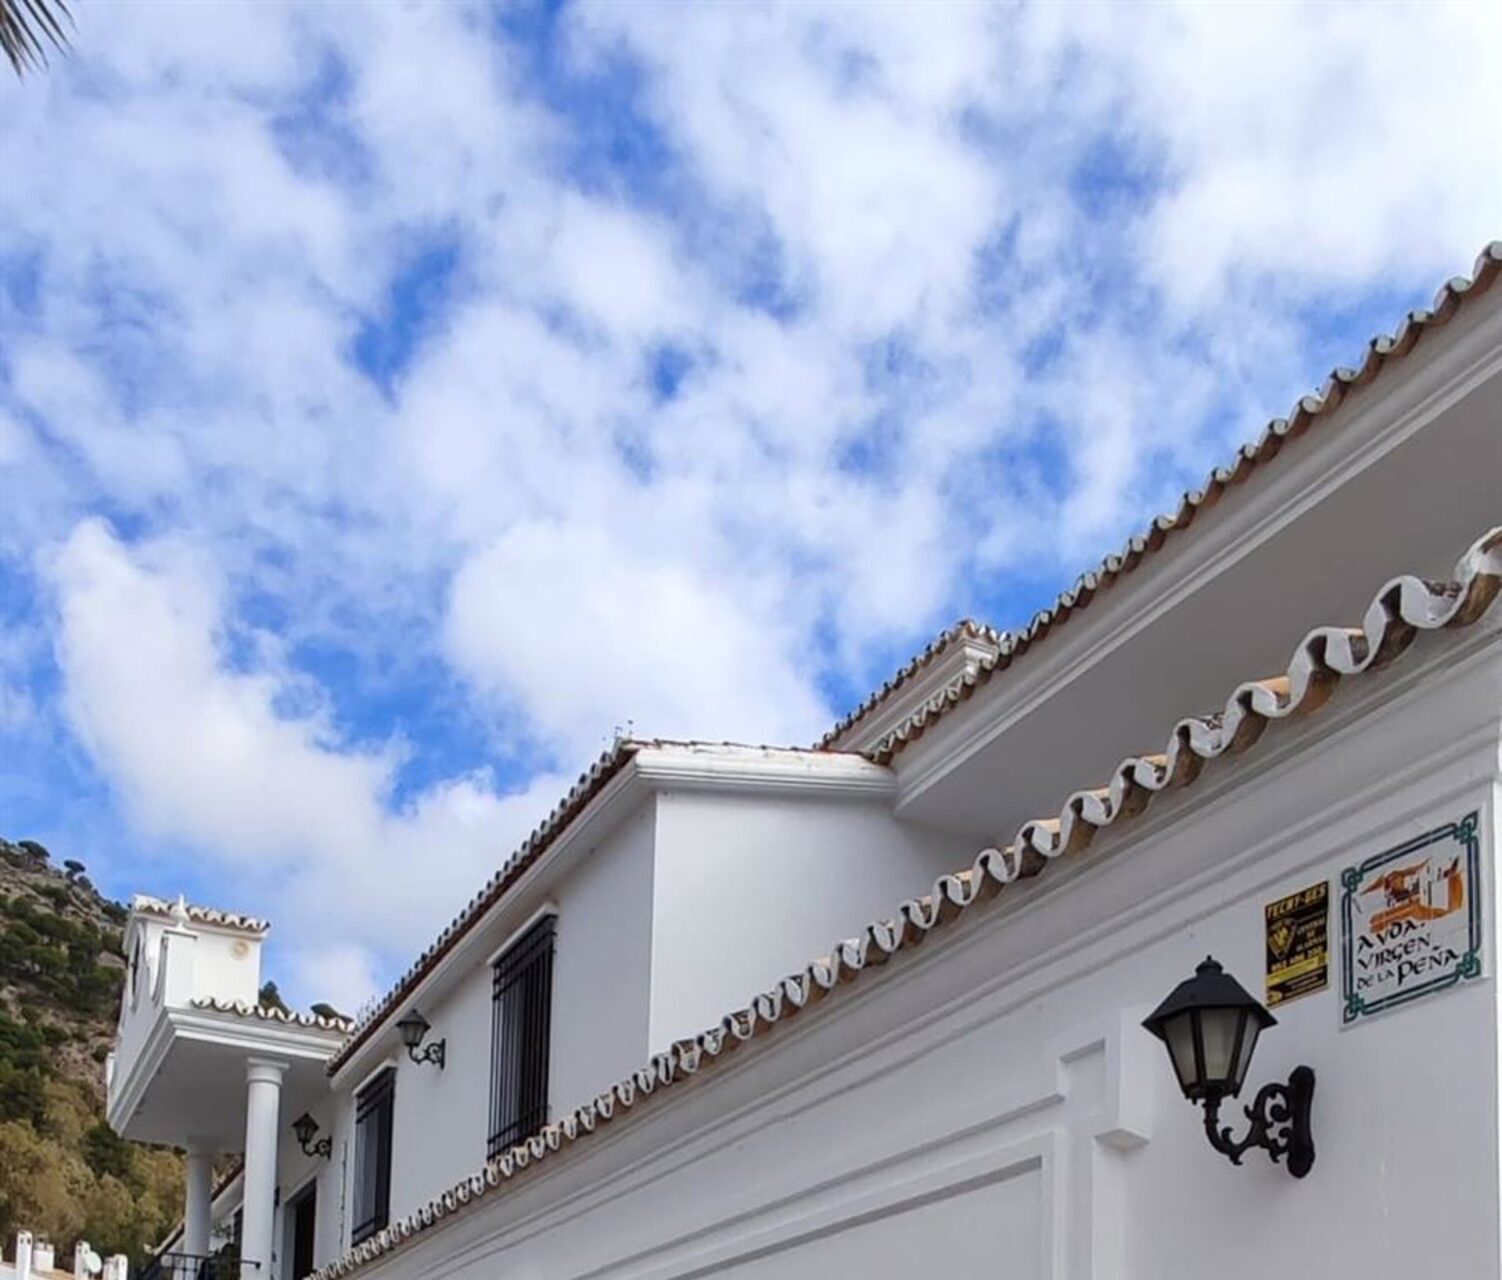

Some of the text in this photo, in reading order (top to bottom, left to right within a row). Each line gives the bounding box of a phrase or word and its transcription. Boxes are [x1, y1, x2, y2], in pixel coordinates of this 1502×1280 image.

[1358, 932, 1431, 969] VIRGEN
[1377, 968, 1395, 982] LA
[1397, 944, 1459, 986] PEÑA
